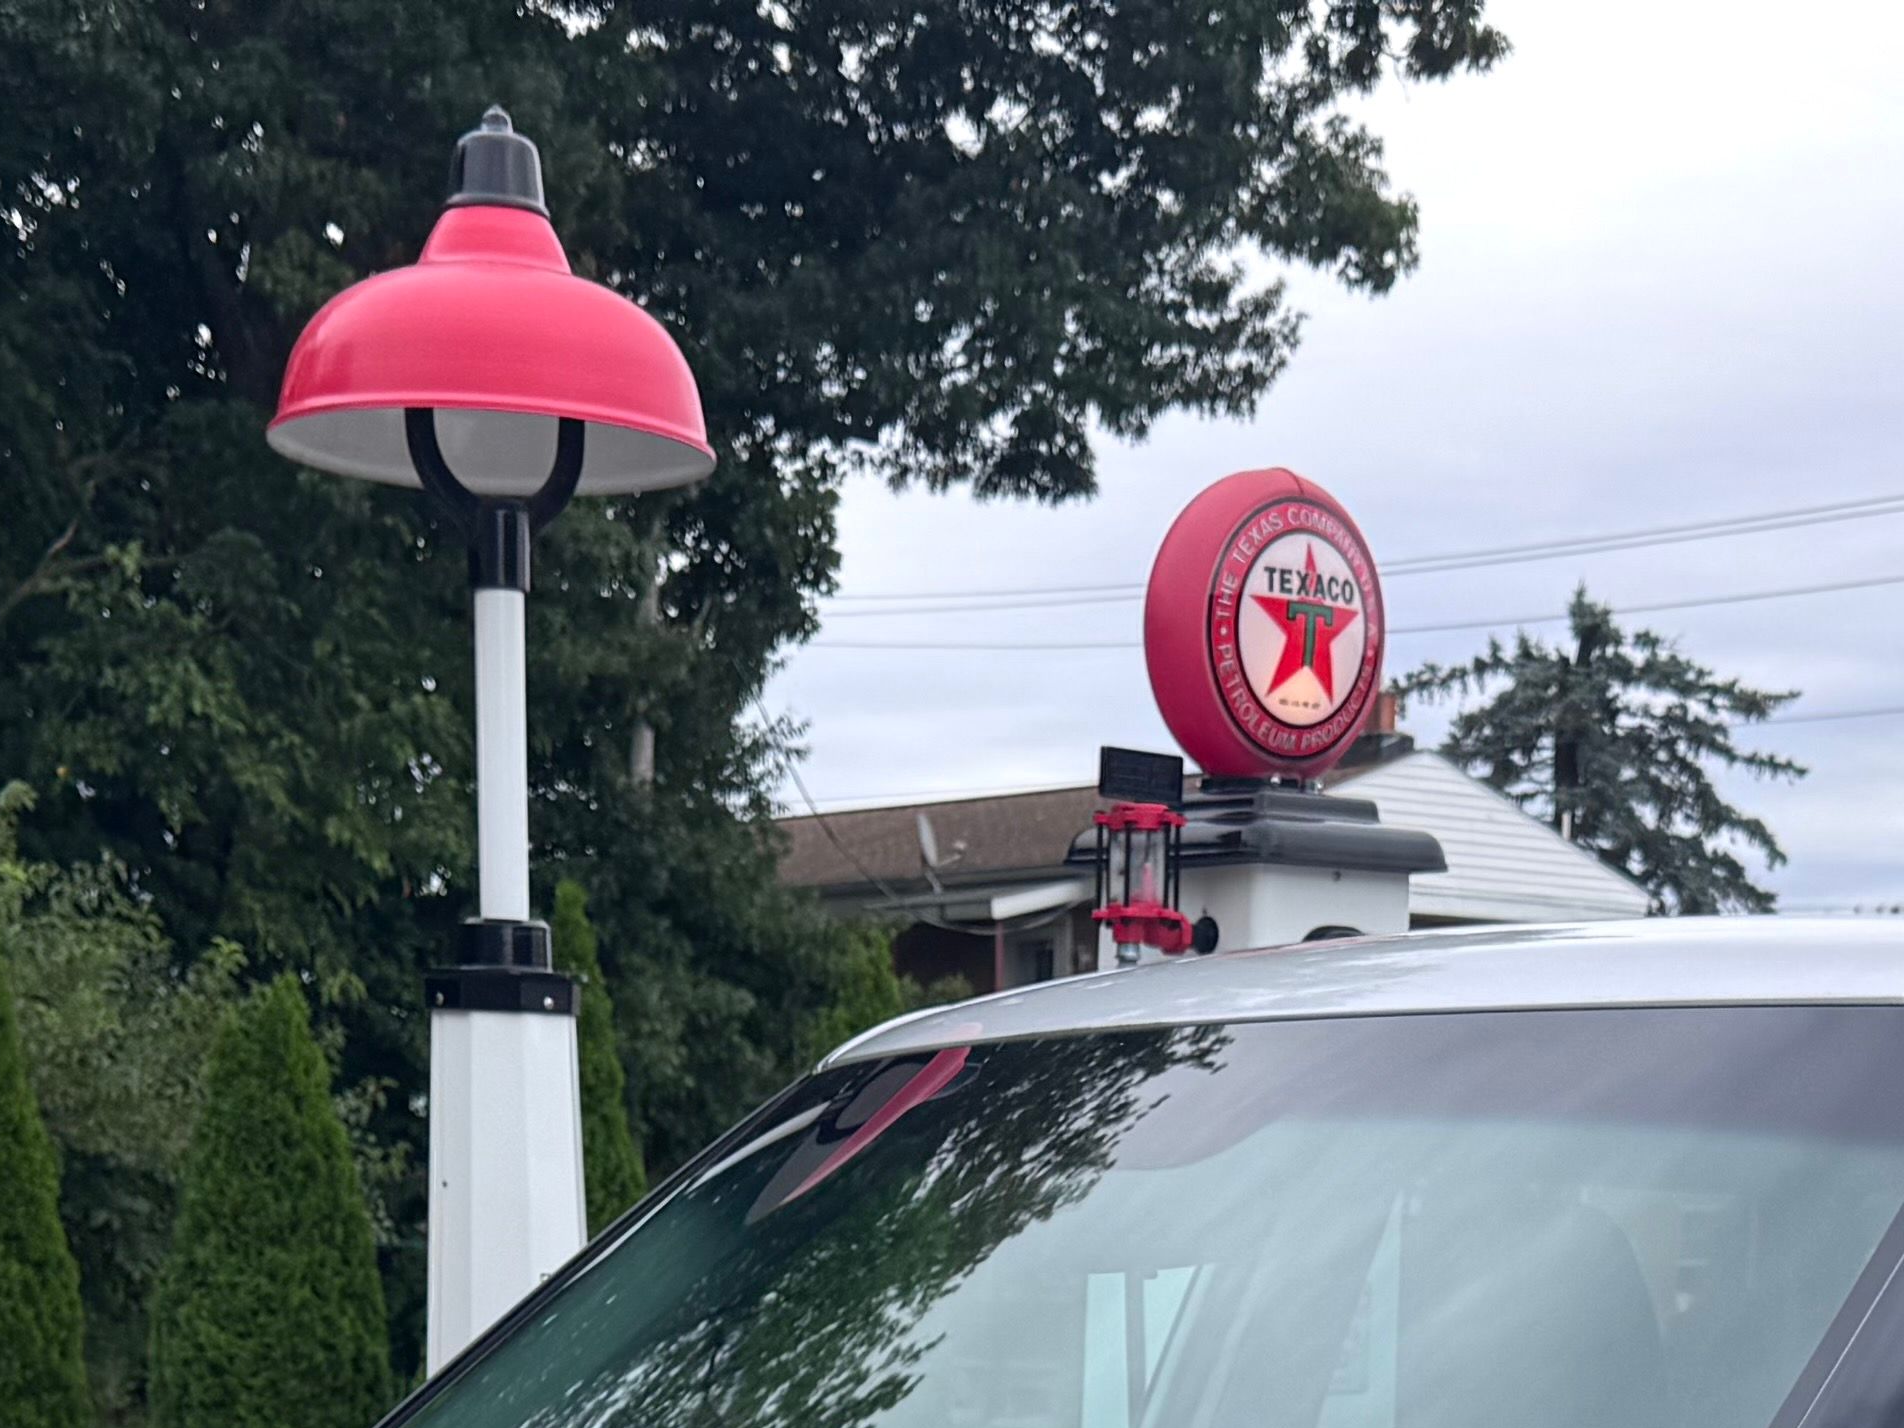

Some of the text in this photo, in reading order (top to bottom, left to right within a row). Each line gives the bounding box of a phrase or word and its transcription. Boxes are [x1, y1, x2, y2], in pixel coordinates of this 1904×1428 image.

[1215, 571, 1238, 619] THE
[1232, 511, 1284, 564] TEXAS
[1264, 566, 1355, 605] TEXACO
[1287, 601, 1334, 669] T
[1216, 645, 1296, 750] PETROLEUM
